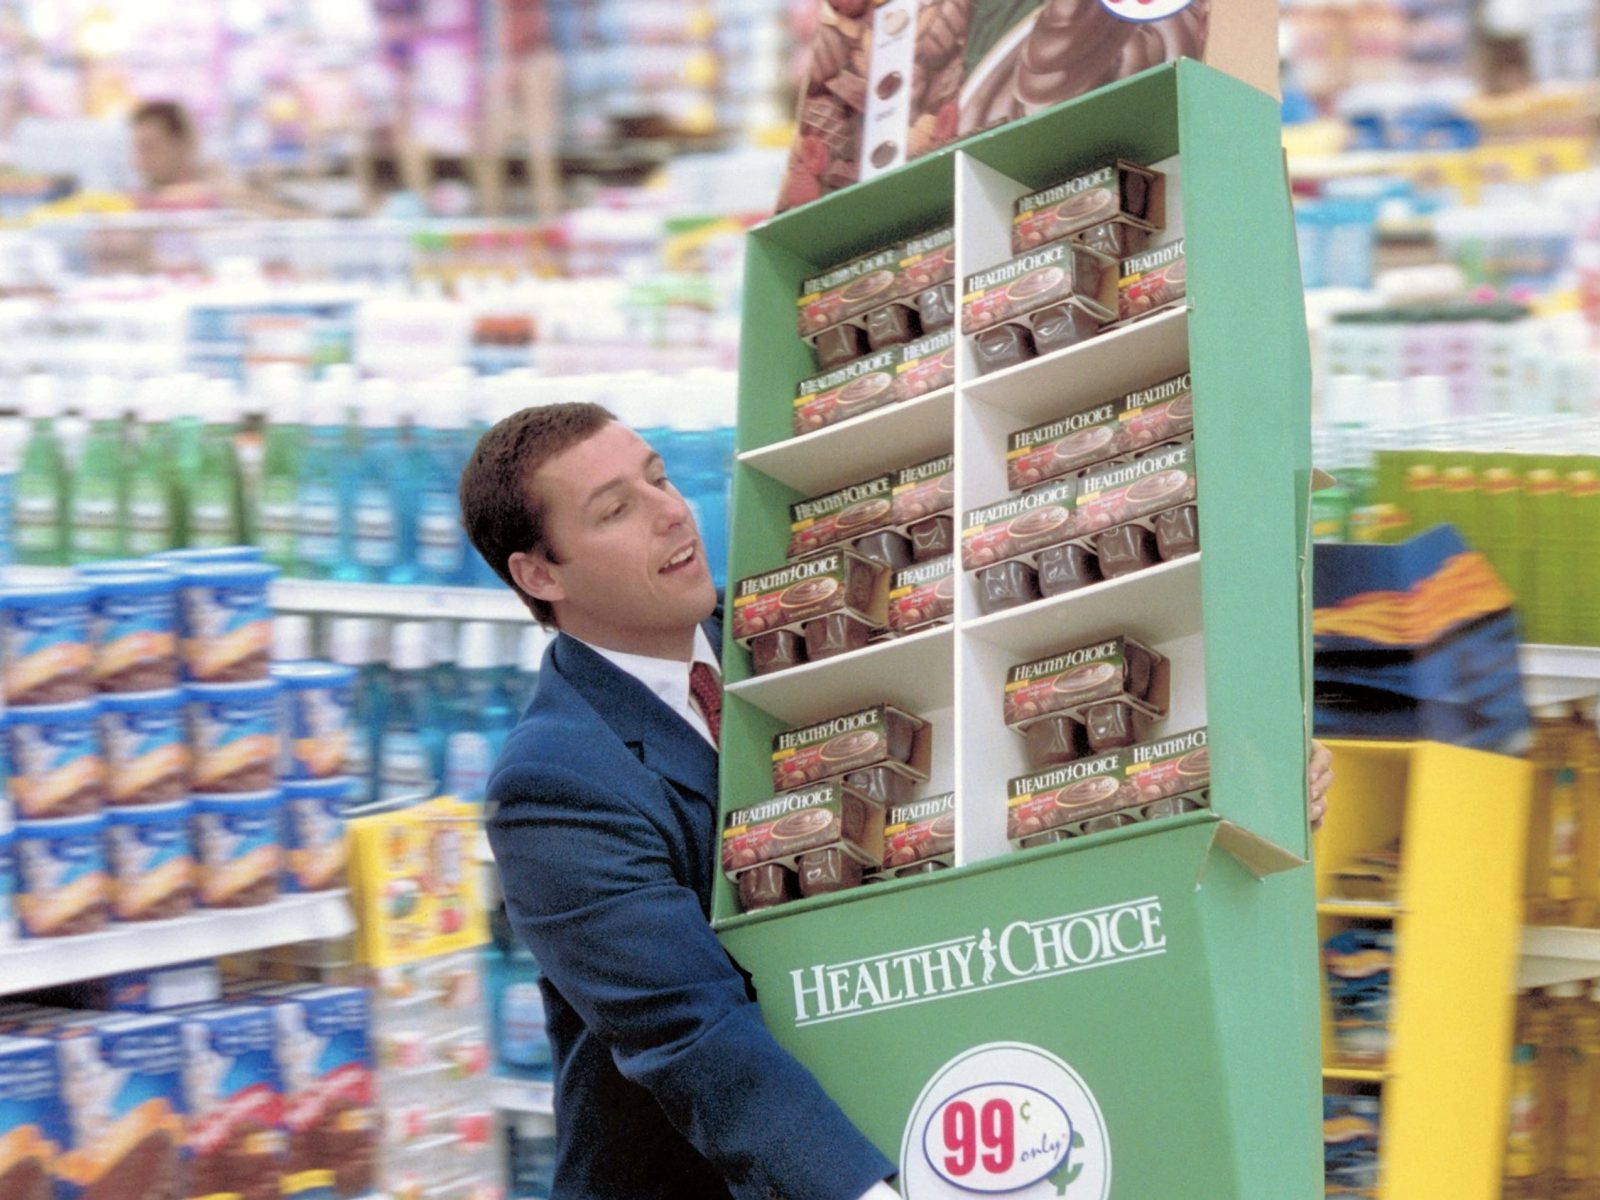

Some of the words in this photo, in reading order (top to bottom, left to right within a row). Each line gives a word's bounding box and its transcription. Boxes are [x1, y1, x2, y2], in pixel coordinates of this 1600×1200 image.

[1070, 166, 1113, 194] CHOICE
[969, 262, 1017, 292] HEALTHY
[1022, 246, 1064, 271] CHOICE
[1124, 245, 1174, 276] HEALTHY
[1126, 380, 1176, 409] HEALTHY
[1015, 421, 1067, 448] HEALTHY
[1070, 404, 1114, 429] CHOICE
[848, 477, 891, 500] CHOICE
[1085, 467, 1137, 494] HEALTHY
[1141, 449, 1187, 475] CHOICE
[969, 501, 1020, 527] HEALTHY
[1025, 485, 1069, 511] CHOICE
[742, 571, 792, 596] HEALTHY
[794, 556, 839, 580] CHOICE
[1014, 656, 1067, 681] HEALTHY
[1072, 641, 1117, 664] CHOICE
[779, 725, 830, 749] HEALTHY
[834, 709, 879, 732] CHOICE
[1134, 739, 1188, 763] HEALTHY
[1015, 771, 1068, 796] HEALTHY
[1073, 755, 1119, 777] CHOICE
[732, 801, 784, 827] HEALTHY
[788, 788, 833, 813] CHOICE
[891, 798, 943, 825] HEALTHY
[789, 941, 978, 1021] HEALTHY
[999, 901, 1167, 976] CHOICE
[1020, 1132, 1061, 1161] only
